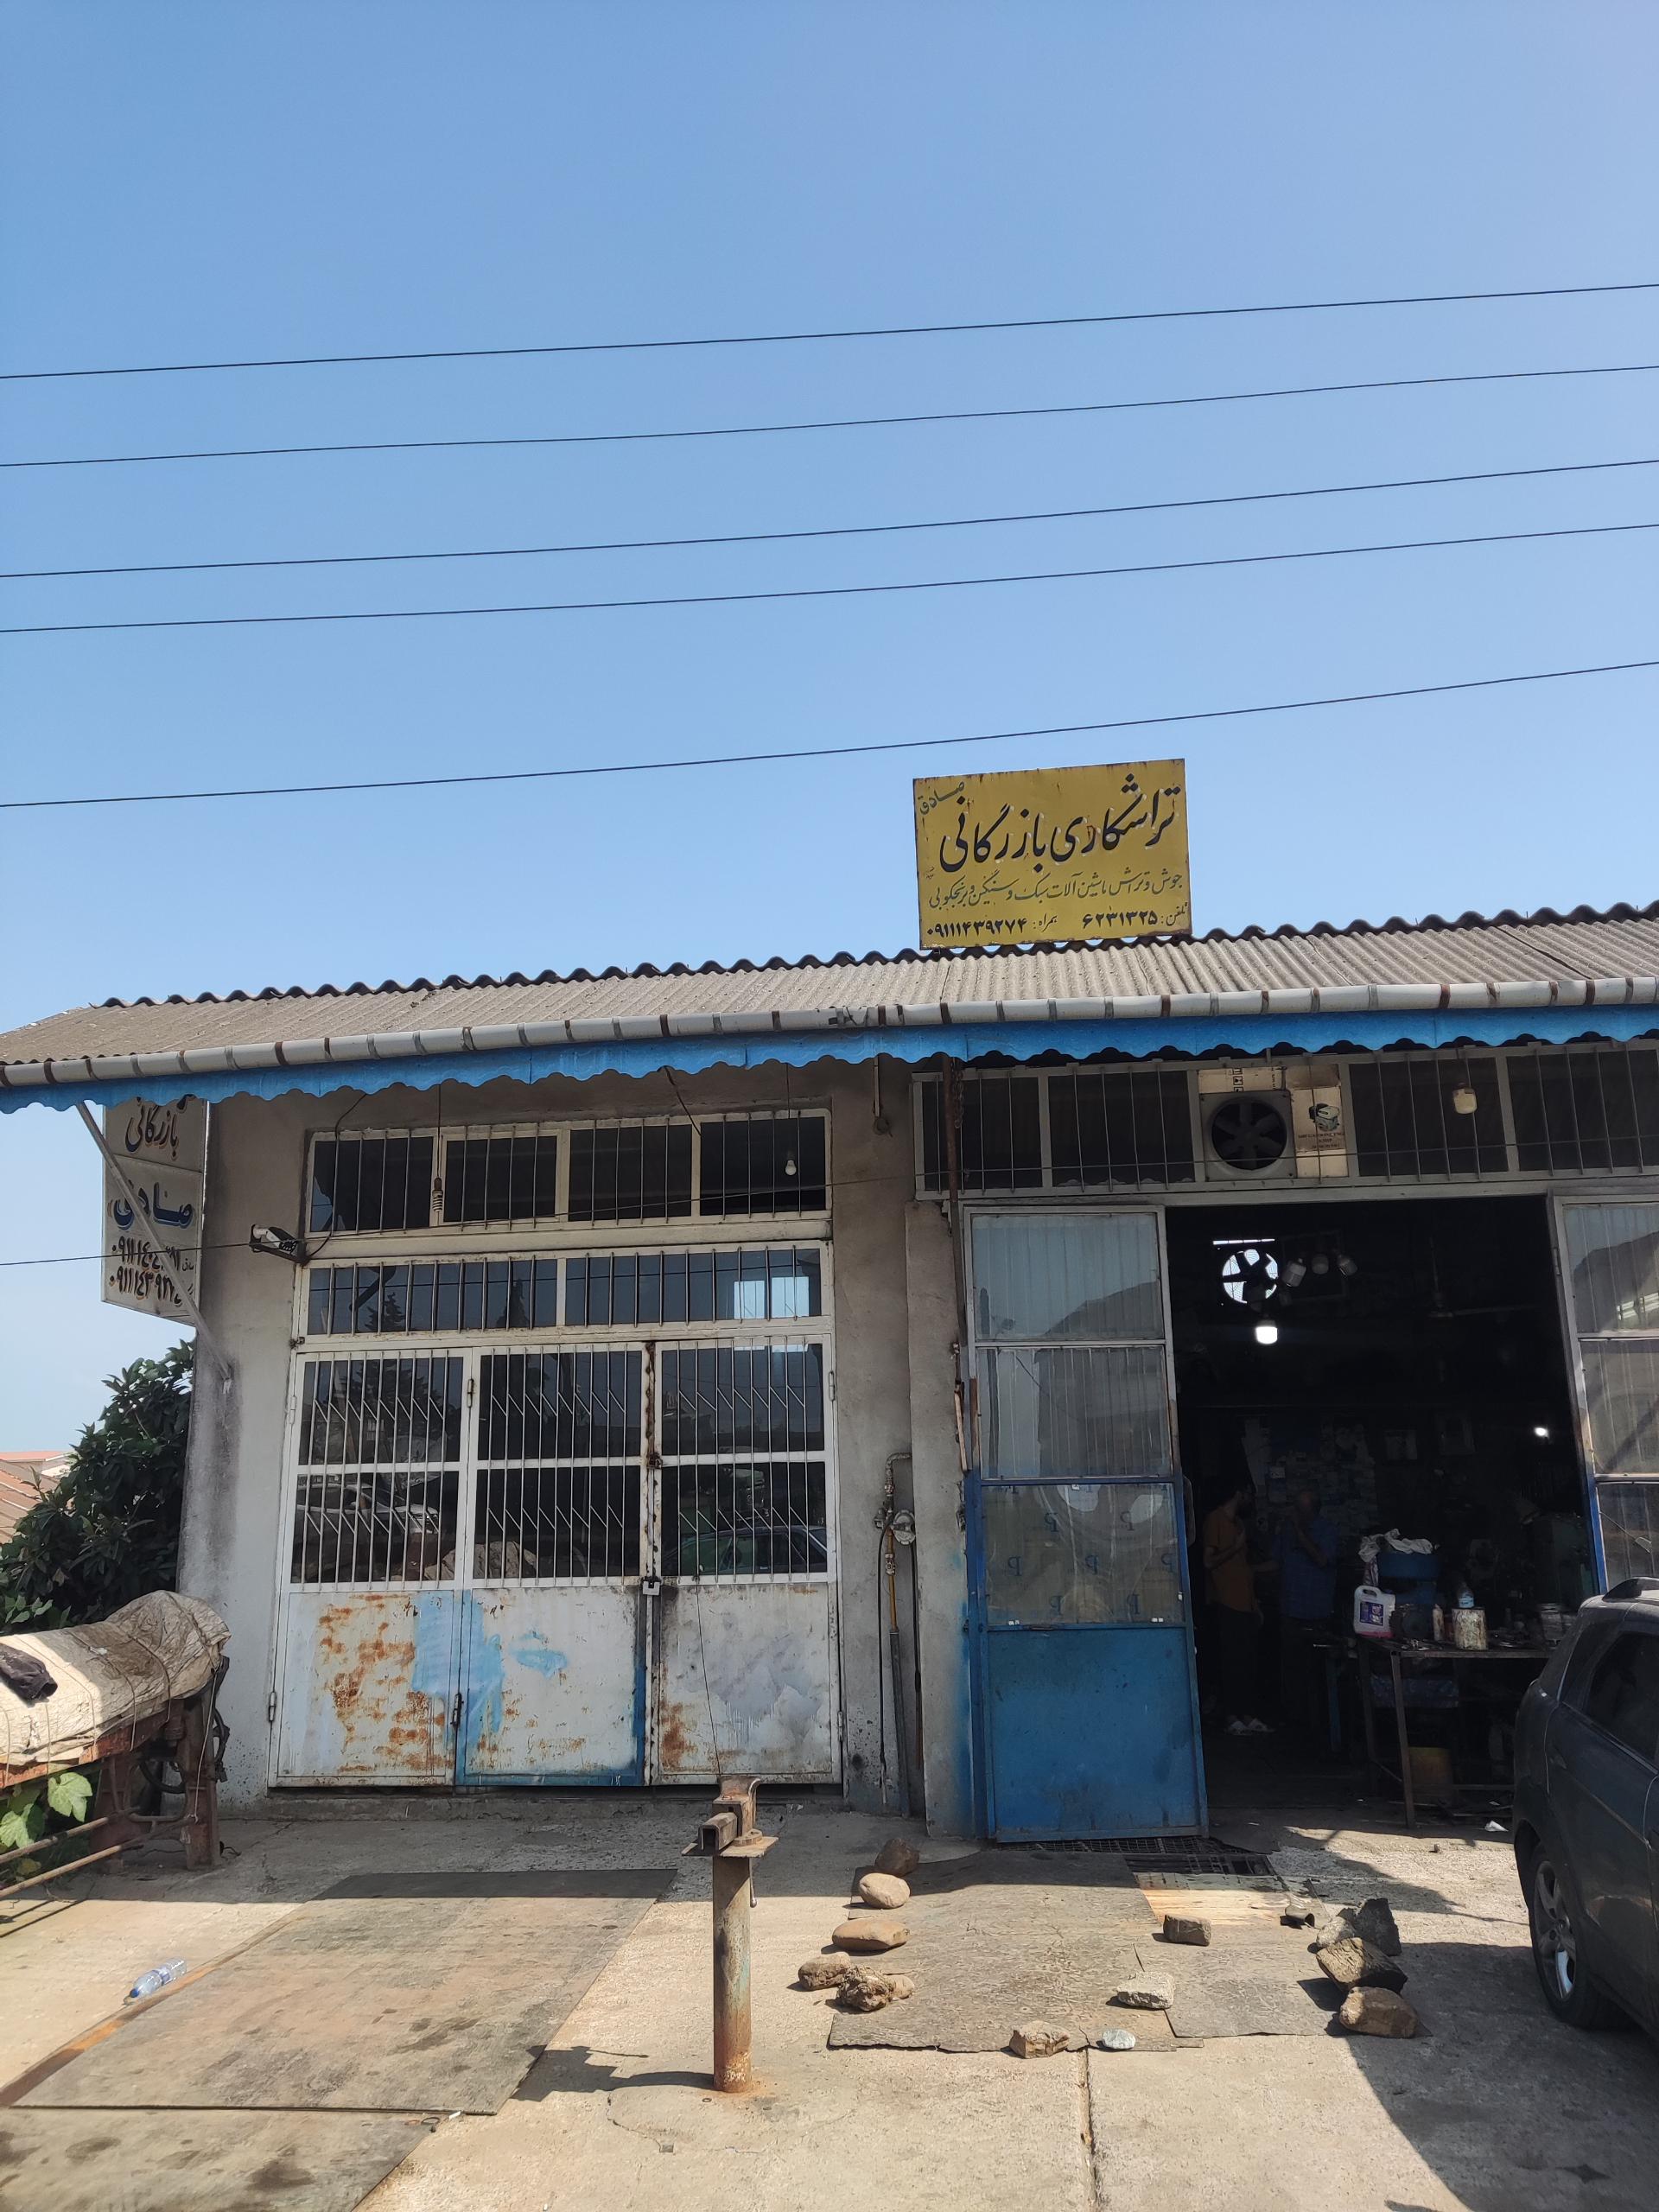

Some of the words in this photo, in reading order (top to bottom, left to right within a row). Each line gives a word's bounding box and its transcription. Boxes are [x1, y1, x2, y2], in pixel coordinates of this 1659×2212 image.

[918, 779, 965, 816] صادق
[1049, 772, 1181, 862] تراشکاری
[939, 795, 1048, 874] بازرگانی
[1151, 868, 1183, 894] جوش
